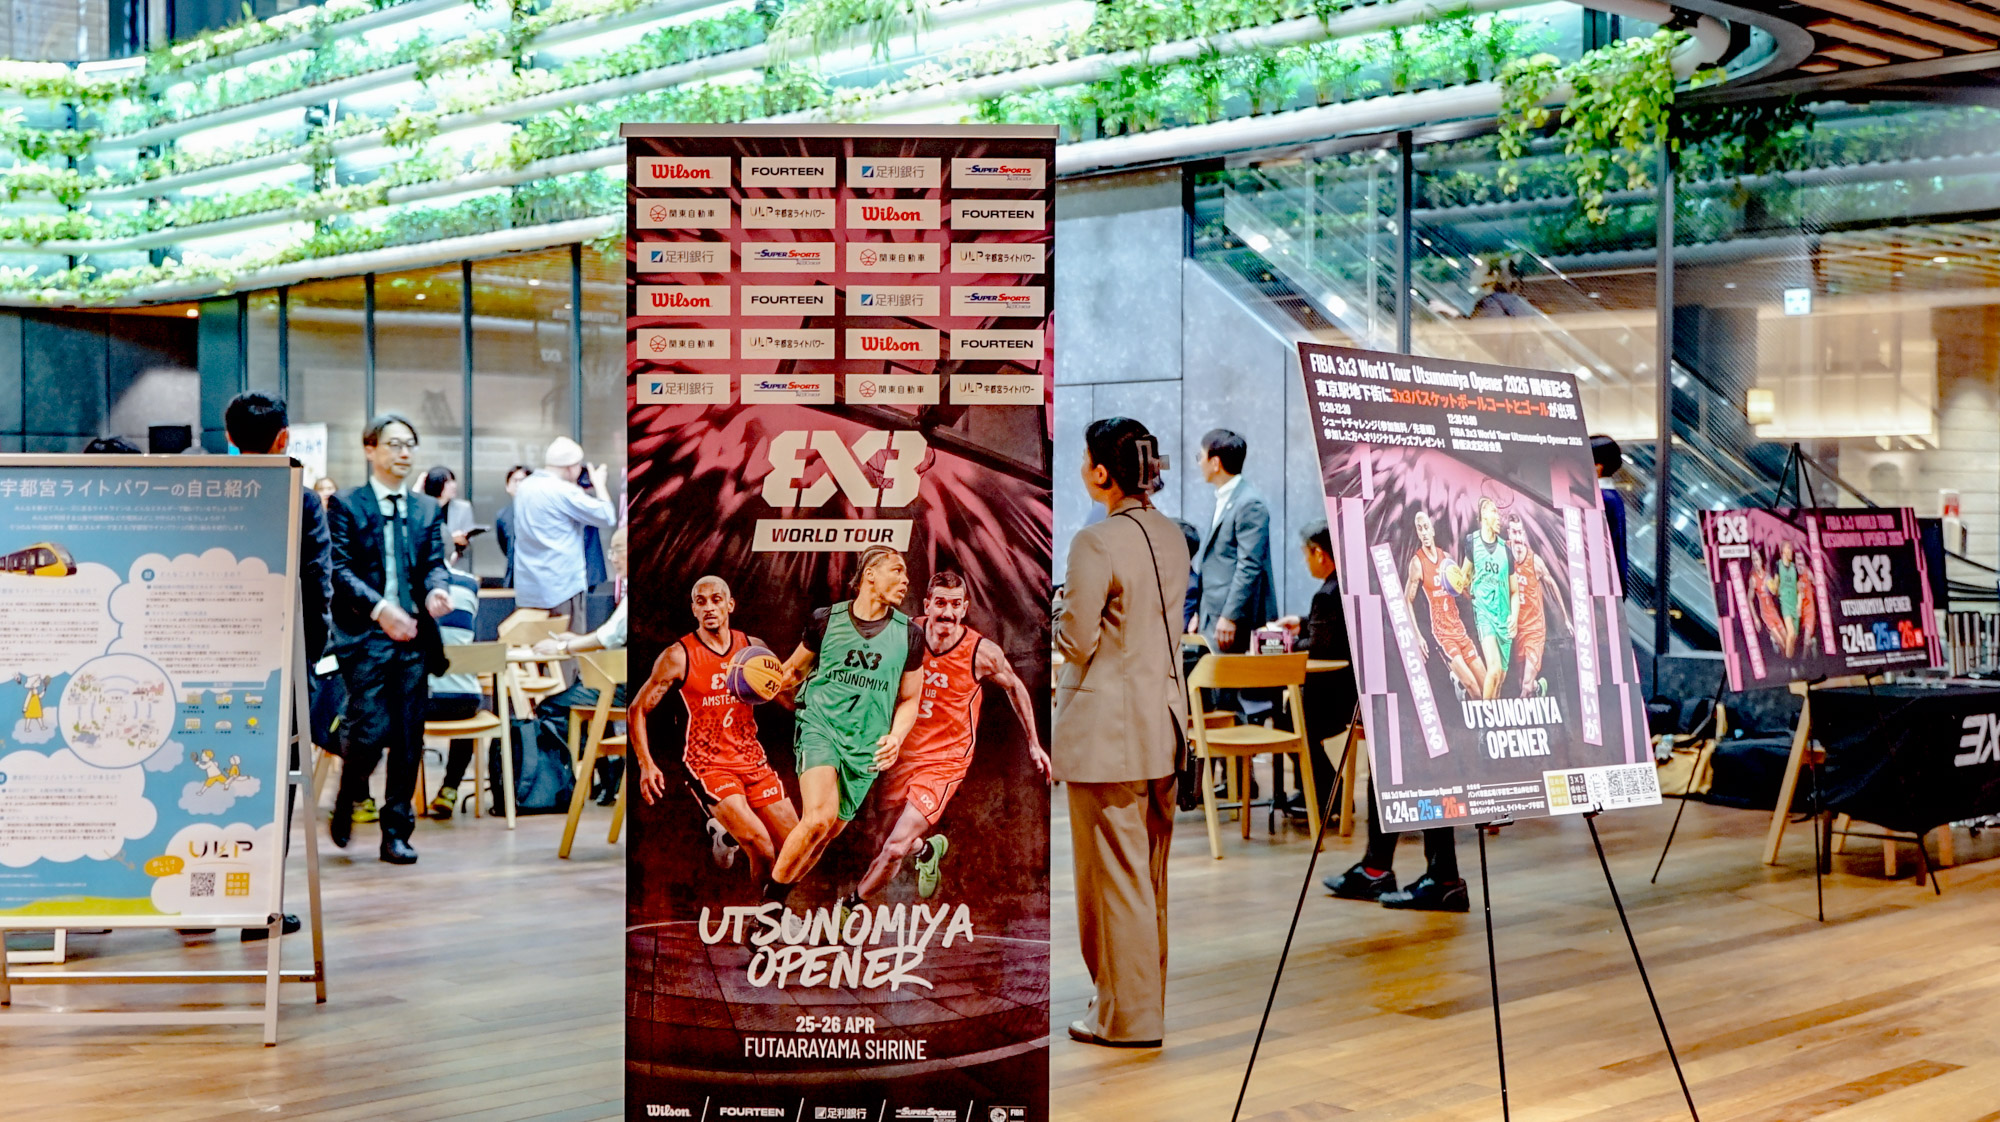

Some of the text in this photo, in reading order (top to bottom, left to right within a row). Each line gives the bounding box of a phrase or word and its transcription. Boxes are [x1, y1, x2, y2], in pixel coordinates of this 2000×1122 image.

[651, 164, 711, 179] Wilson
[752, 167, 824, 176] FOURTEEN
[876, 166, 924, 178] 足利銀行
[669, 210, 714, 218] 関東自動車
[775, 209, 825, 218] 宇都宮ライトパワー
[861, 207, 921, 221] Wilson
[962, 210, 1034, 218] FOURTEEN
[666, 251, 713, 262] 足利銀行
[880, 254, 924, 262] 関東自動車
[985, 254, 1035, 262] 宇都宮ライトパワー
[651, 293, 710, 307] Wilson
[751, 296, 823, 304] FOURTEEN
[876, 294, 923, 306] 足利銀行
[669, 340, 714, 348] 関東自動車
[775, 340, 824, 348] 宇都宮ライトパワー
[861, 336, 920, 351] Wilson
[961, 340, 1033, 348] FOURTEEN
[1309, 353, 1336, 375] FIBA
[1336, 356, 1357, 377] 3x3
[1358, 358, 1389, 380] World
[1388, 362, 1411, 383] Tour
[1411, 365, 1470, 391] Utsunomiya
[1469, 371, 1503, 393] Opener
[1504, 375, 1530, 395] 2026
[666, 383, 712, 394] 足利銀行
[984, 385, 1034, 393] 宇都宮ライトパワー
[0, 478, 262, 499] 宇都宮ライトパワーの自己紹介
[772, 528, 894, 543] WORLD TOUR
[1840, 596, 1912, 617] UTSUNOMIYA OPENER
[1872, 622, 1891, 651] 25
[1898, 620, 1916, 648] 26
[722, 707, 735, 729] 6
[1461, 696, 1562, 729] UTSUNOMIYA
[1486, 727, 1551, 759] OPENER
[1417, 798, 1434, 821] 25
[1442, 796, 1459, 819] 26
[699, 898, 973, 952] UTSUNOMIYA
[747, 945, 933, 991] OPENER
[796, 1016, 875, 1034] 25-26 APR
[744, 1037, 926, 1060] FUTAARAYAMA SHRINE
[647, 1104, 691, 1117] Wilson
[720, 1107, 784, 1117] FOURTEEN
[827, 1107, 867, 1120] 足利銀行
